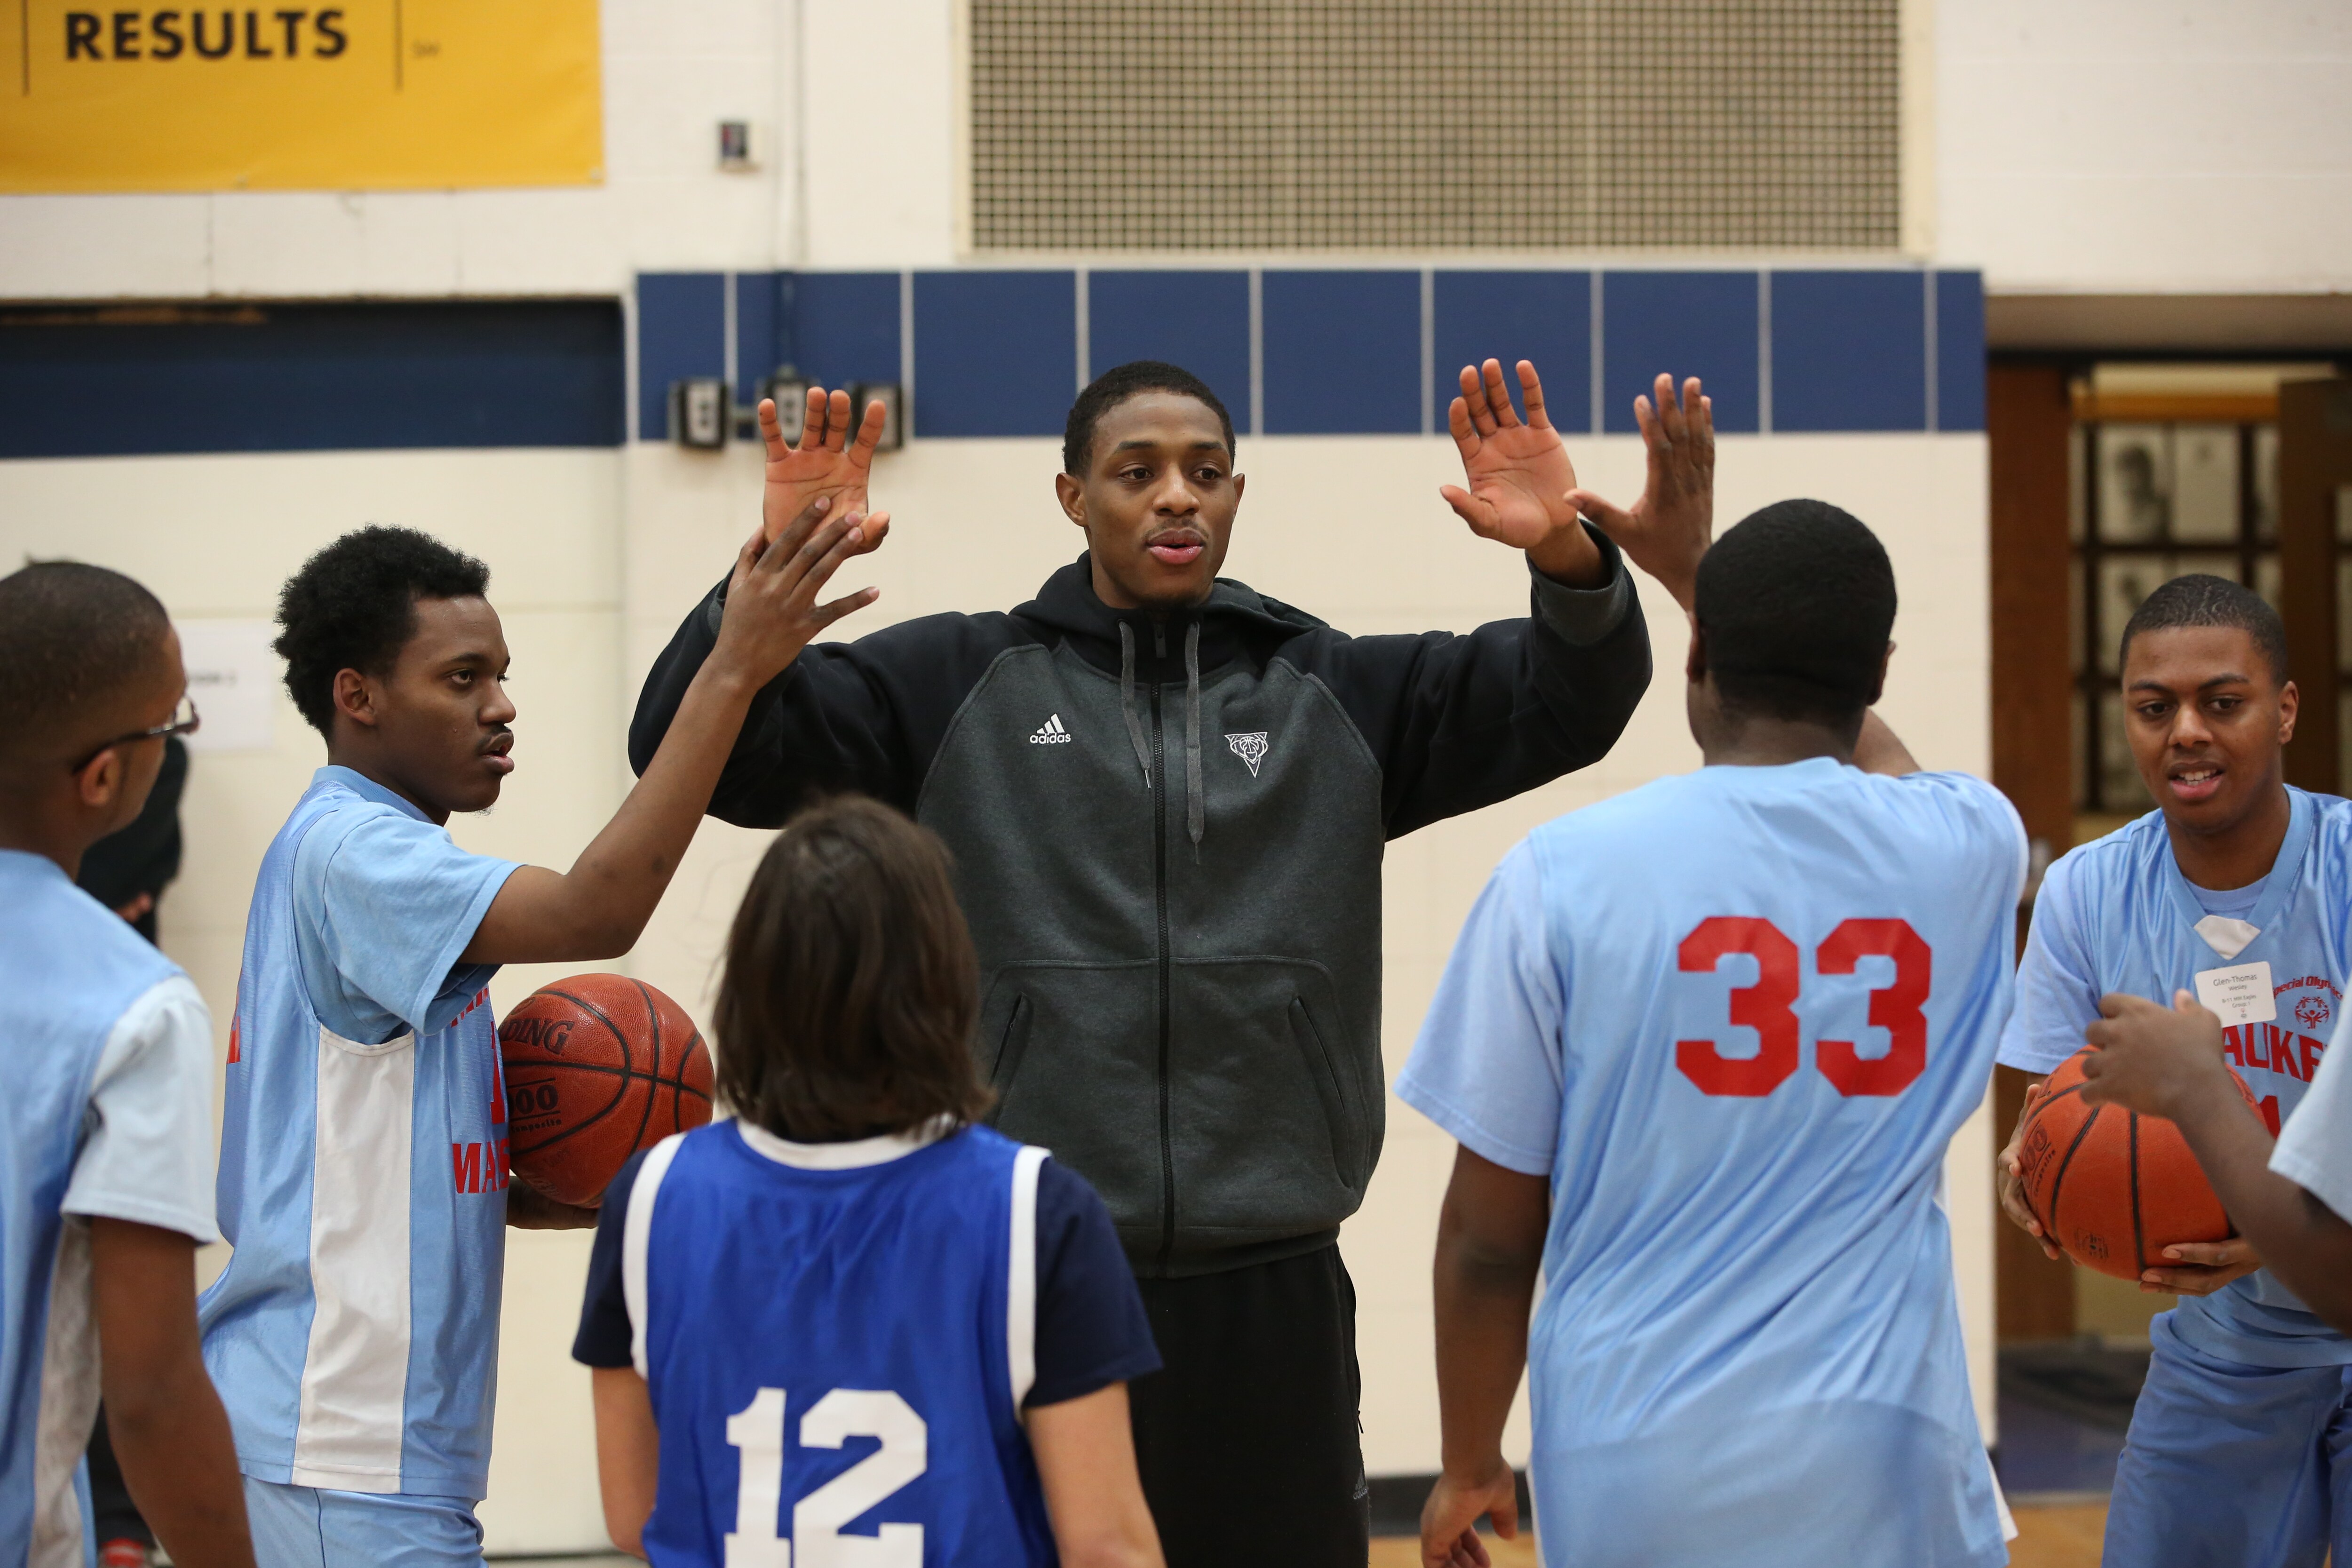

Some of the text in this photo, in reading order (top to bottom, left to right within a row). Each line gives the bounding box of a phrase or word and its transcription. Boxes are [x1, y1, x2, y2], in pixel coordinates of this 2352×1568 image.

[64, 9, 349, 60] RESULTS
[1029, 732, 1071, 744] adidas
[2213, 974, 2257, 986] Glen-Thomas
[2273, 977, 2304, 999] pecial
[1675, 916, 1931, 1097] 33
[2222, 1022, 2328, 1083] AUKE
[723, 1386, 928, 1568] 12
